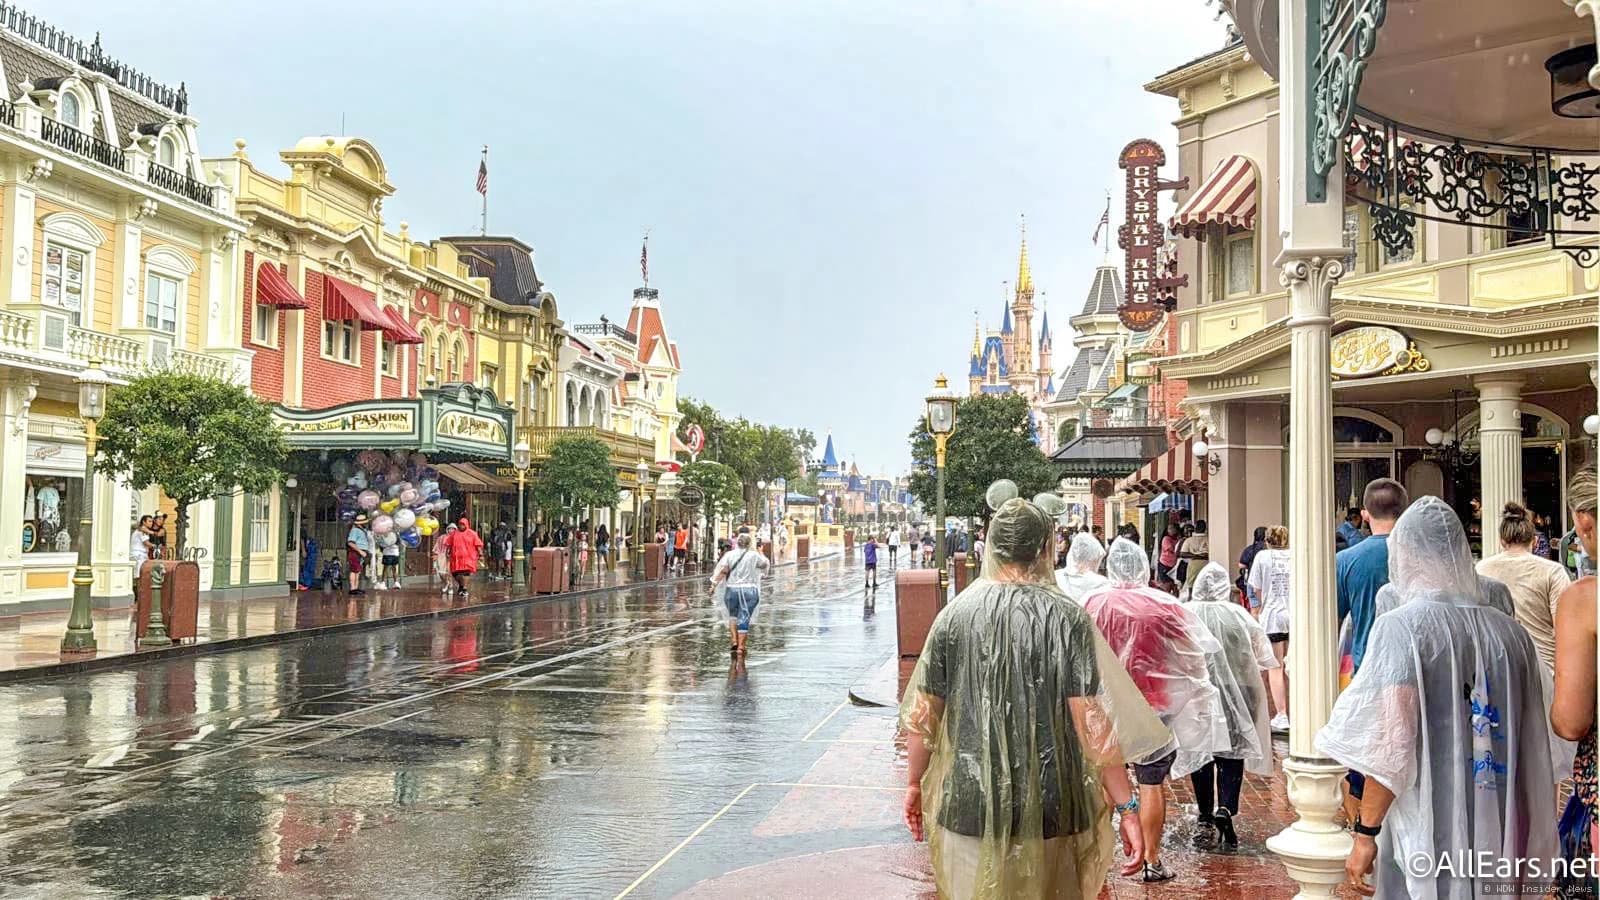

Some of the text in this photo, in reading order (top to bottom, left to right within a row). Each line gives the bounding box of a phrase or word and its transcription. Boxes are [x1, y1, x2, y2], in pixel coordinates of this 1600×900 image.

[1133, 166, 1150, 304] CRYSTAL ARTS
[350, 413, 408, 430] FASHION
[496, 467, 520, 477] HOUS
